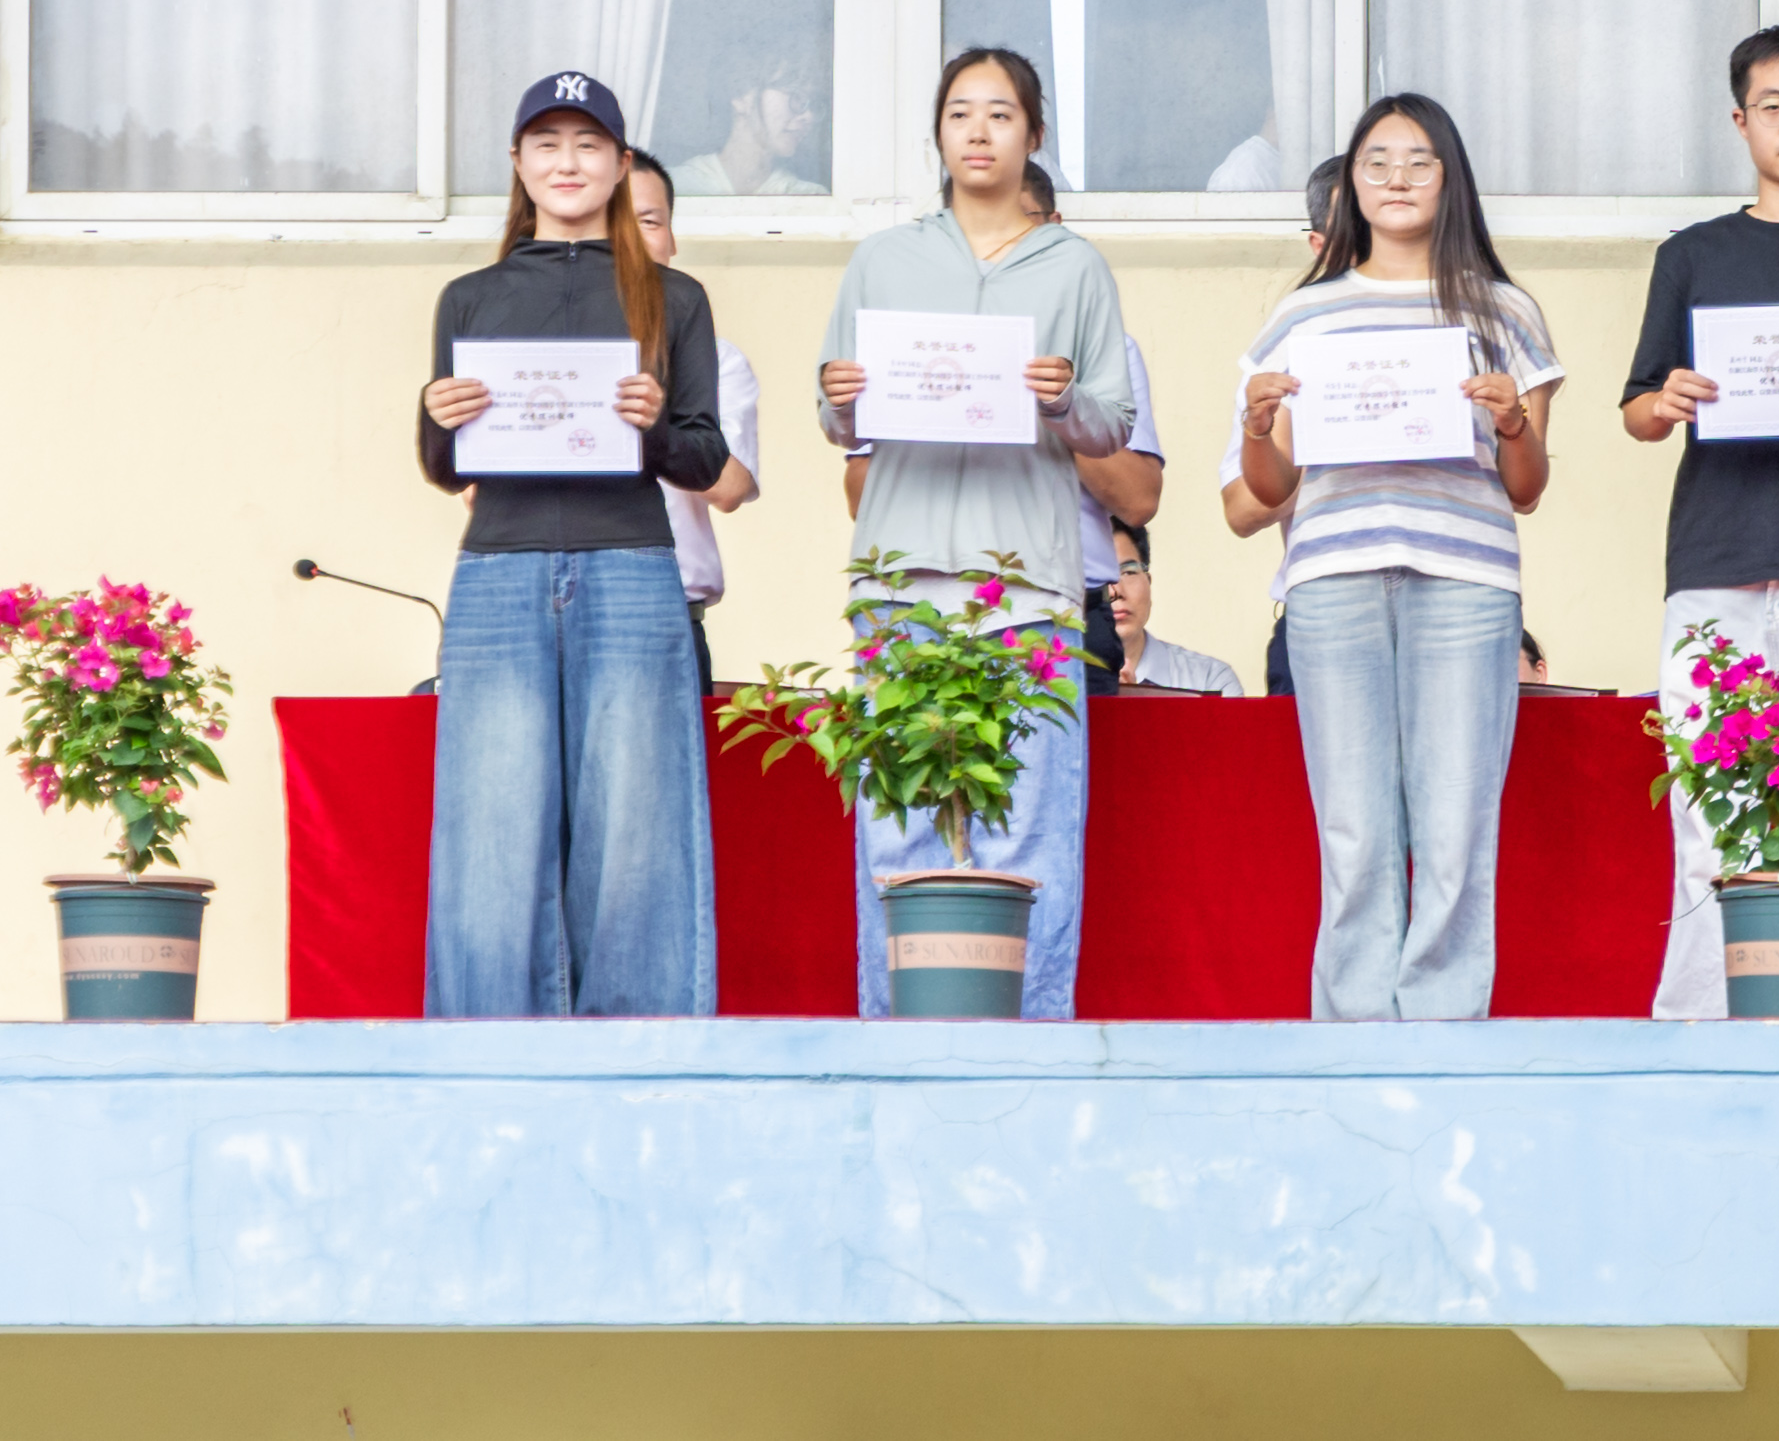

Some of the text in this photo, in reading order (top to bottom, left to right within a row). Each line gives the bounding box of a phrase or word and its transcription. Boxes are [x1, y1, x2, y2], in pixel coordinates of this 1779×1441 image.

[555, 74, 589, 102] NY
[912, 341, 976, 352] 荣誉证书
[1346, 359, 1411, 371] 荣誉证书
[513, 370, 579, 381] 荣誉证书
